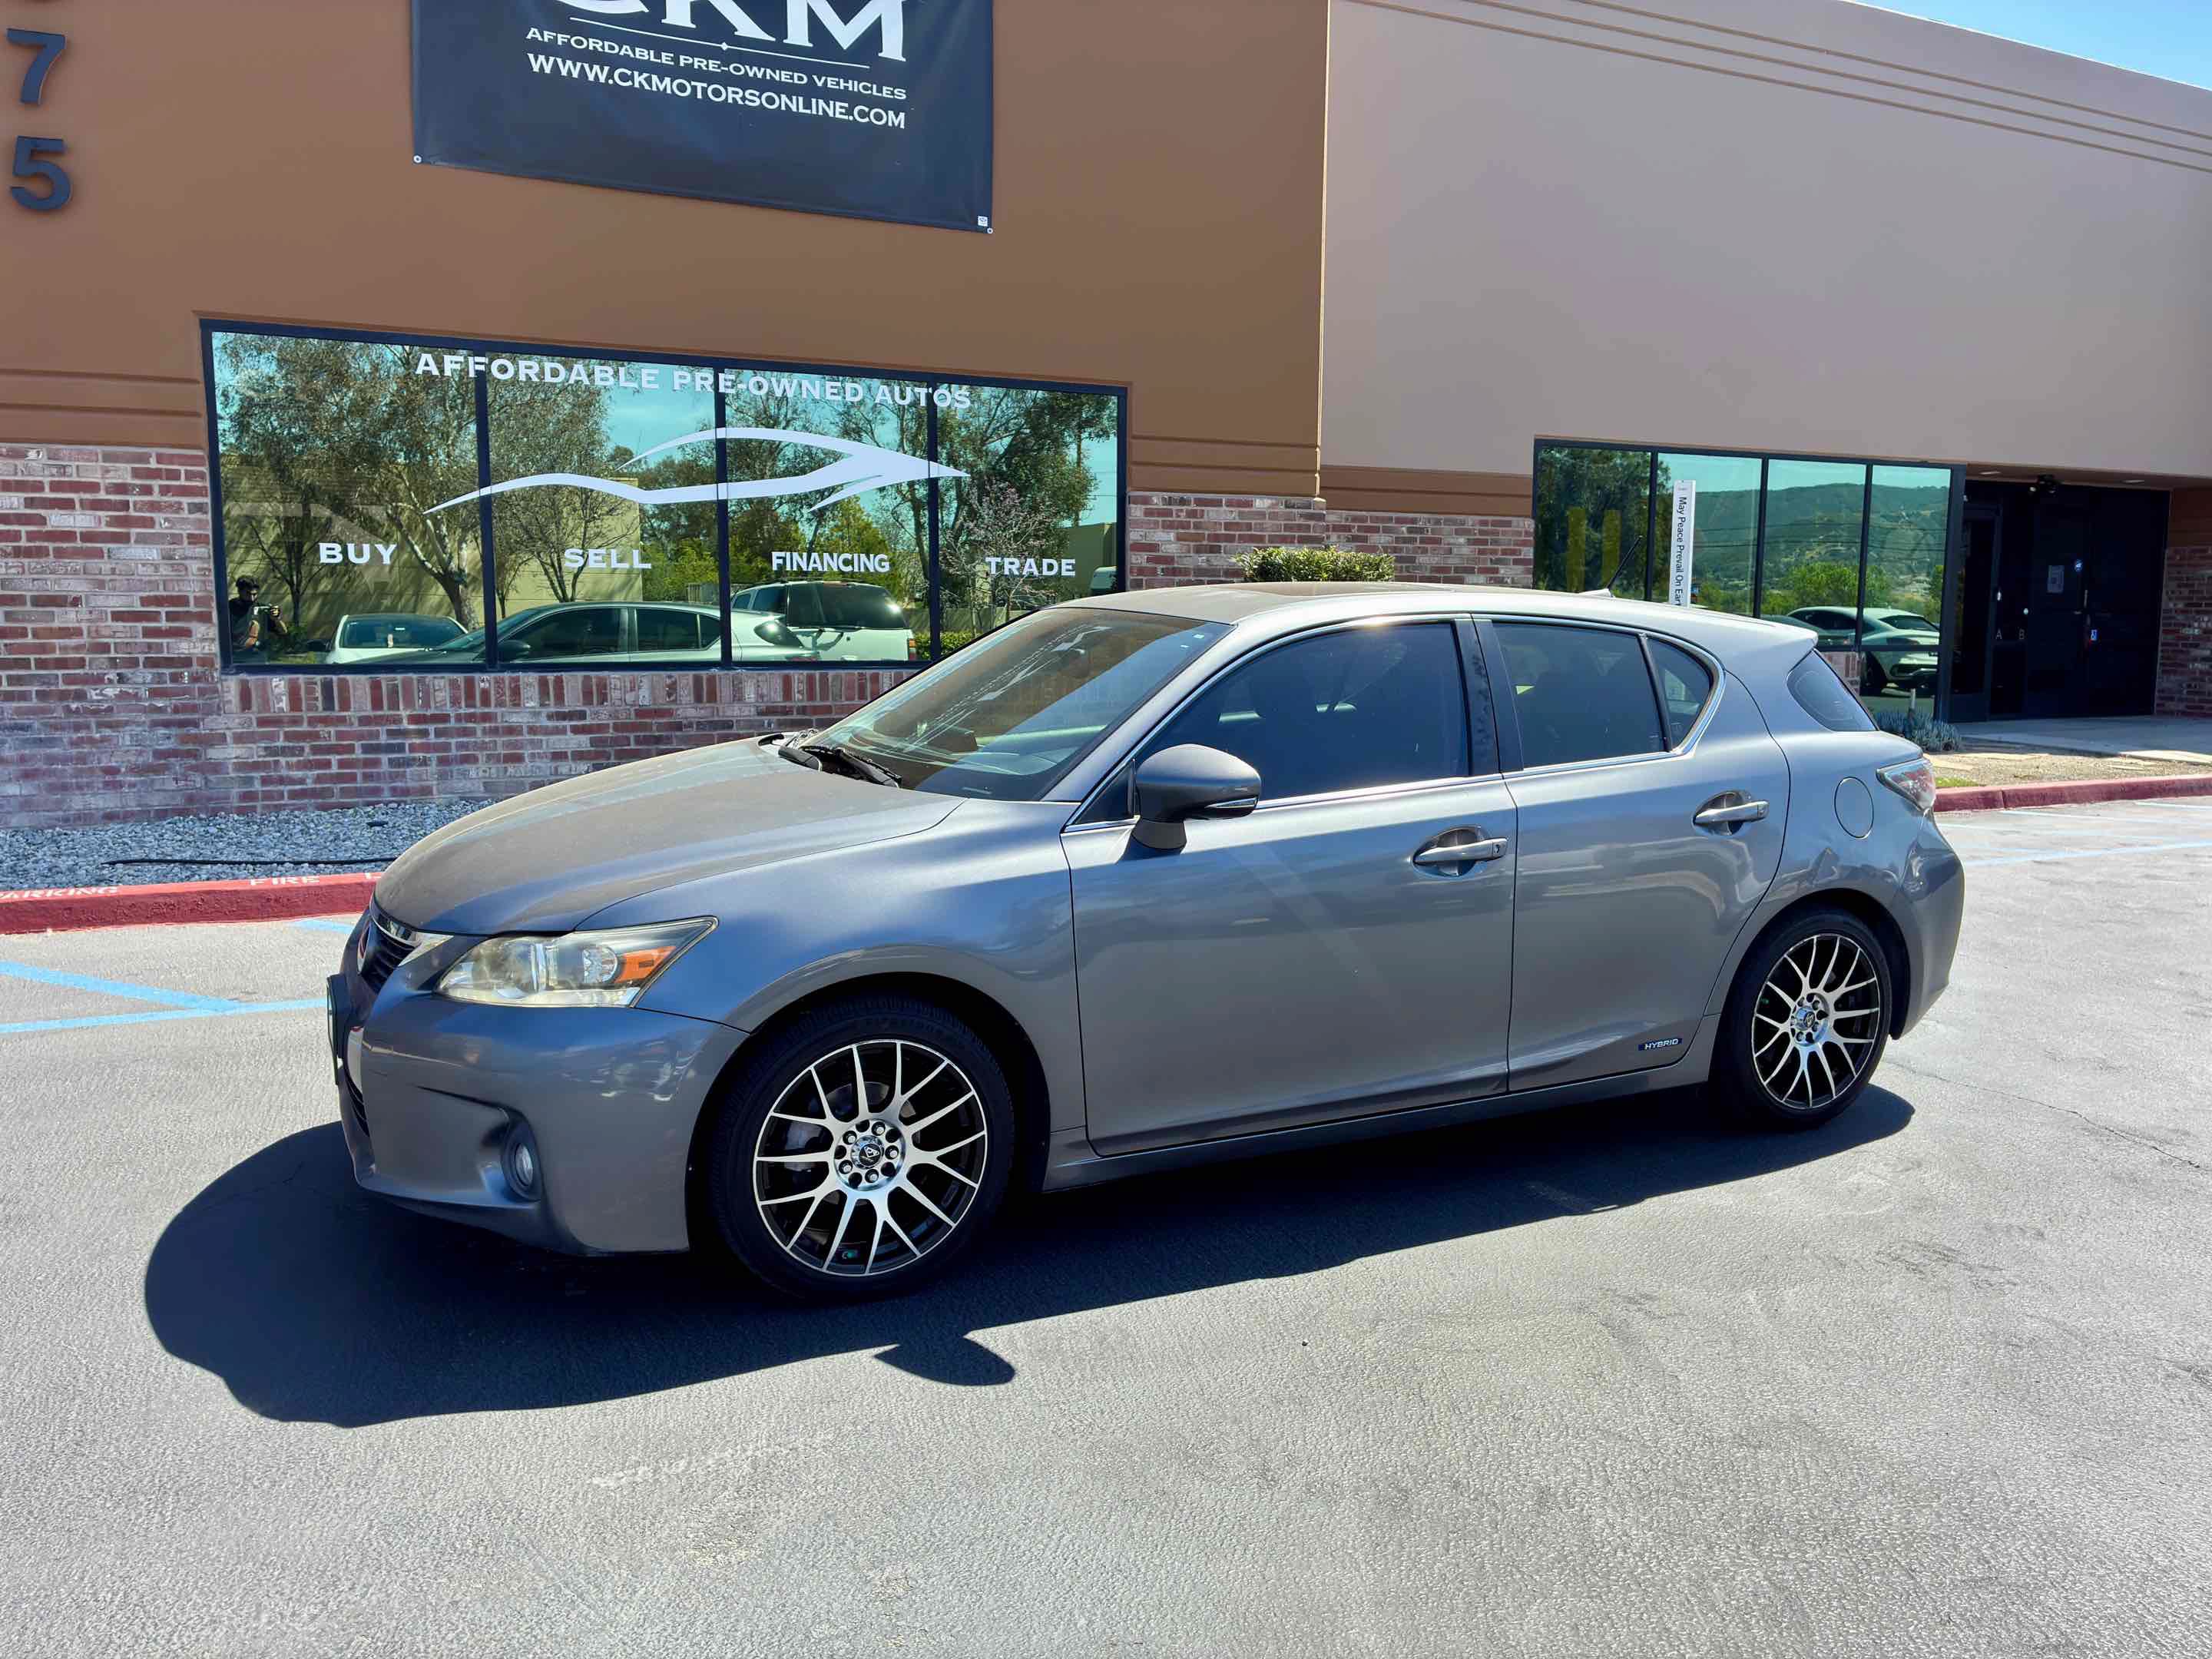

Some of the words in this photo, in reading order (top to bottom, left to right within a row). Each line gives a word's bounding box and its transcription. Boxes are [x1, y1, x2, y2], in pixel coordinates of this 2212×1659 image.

[558, 0, 907, 61] KM
[526, 28, 674, 65] AFFORDABLE
[679, 56, 807, 84] PRE-OWNED
[812, 75, 906, 101] VEHICLES
[528, 53, 906, 130] WWW.CKMOTORSONLINE.COM
[416, 353, 660, 389] AFFORDABLE
[673, 369, 863, 402] PRE-OWNED
[873, 384, 972, 409] AUTOS
[1677, 497, 1687, 515] May
[1677, 516, 1686, 542] Peace
[319, 542, 398, 565] BUY
[564, 548, 652, 569] SELL
[771, 551, 890, 572] FINANCING
[1676, 545, 1684, 573] Prevail
[985, 557, 1076, 577] TRADE
[1675, 575, 1684, 587] On
[250, 876, 321, 886] FIRE
[1644, 1038, 1679, 1050] HYBRID
